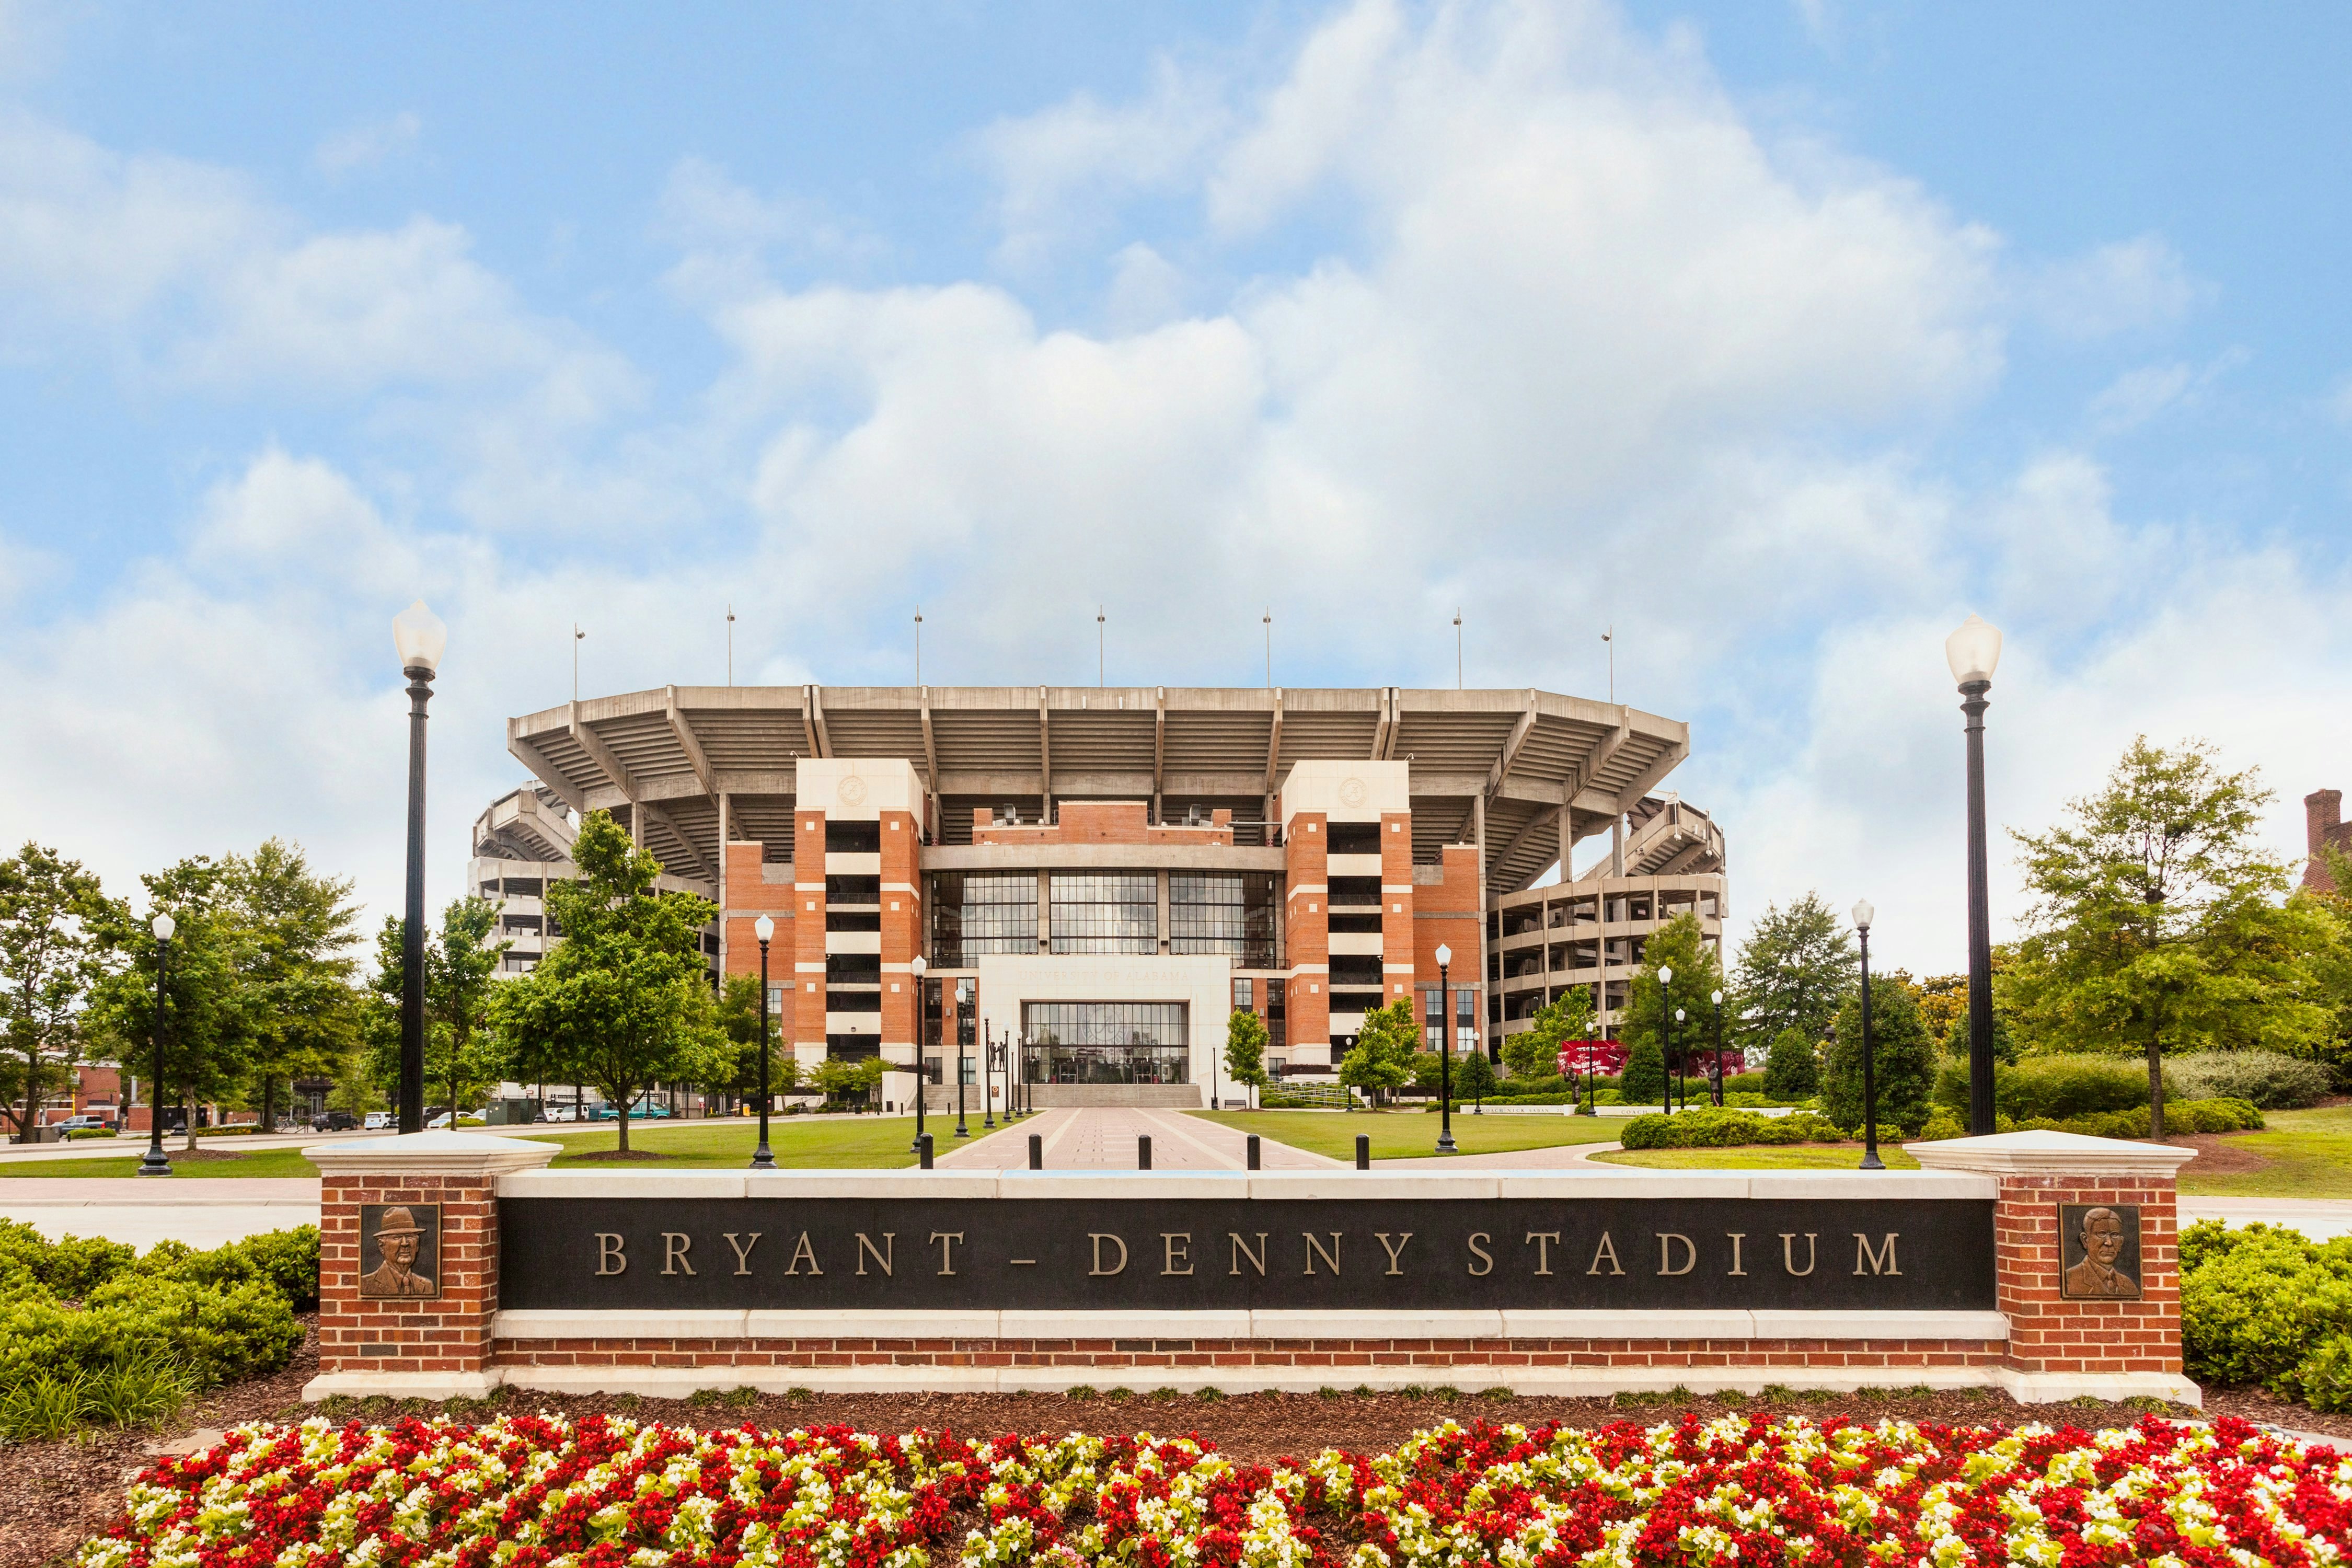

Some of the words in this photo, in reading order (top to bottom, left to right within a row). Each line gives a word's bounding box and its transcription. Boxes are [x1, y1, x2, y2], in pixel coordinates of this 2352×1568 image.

[1019, 971, 1098, 981] UNIVERSITY
[1103, 971, 1120, 981] OF
[1126, 971, 1189, 981] ALABAMA
[594, 1231, 964, 1275] BRYANT
[1088, 1232, 1413, 1276] DENNY
[1468, 1231, 1903, 1276] STADIUM
